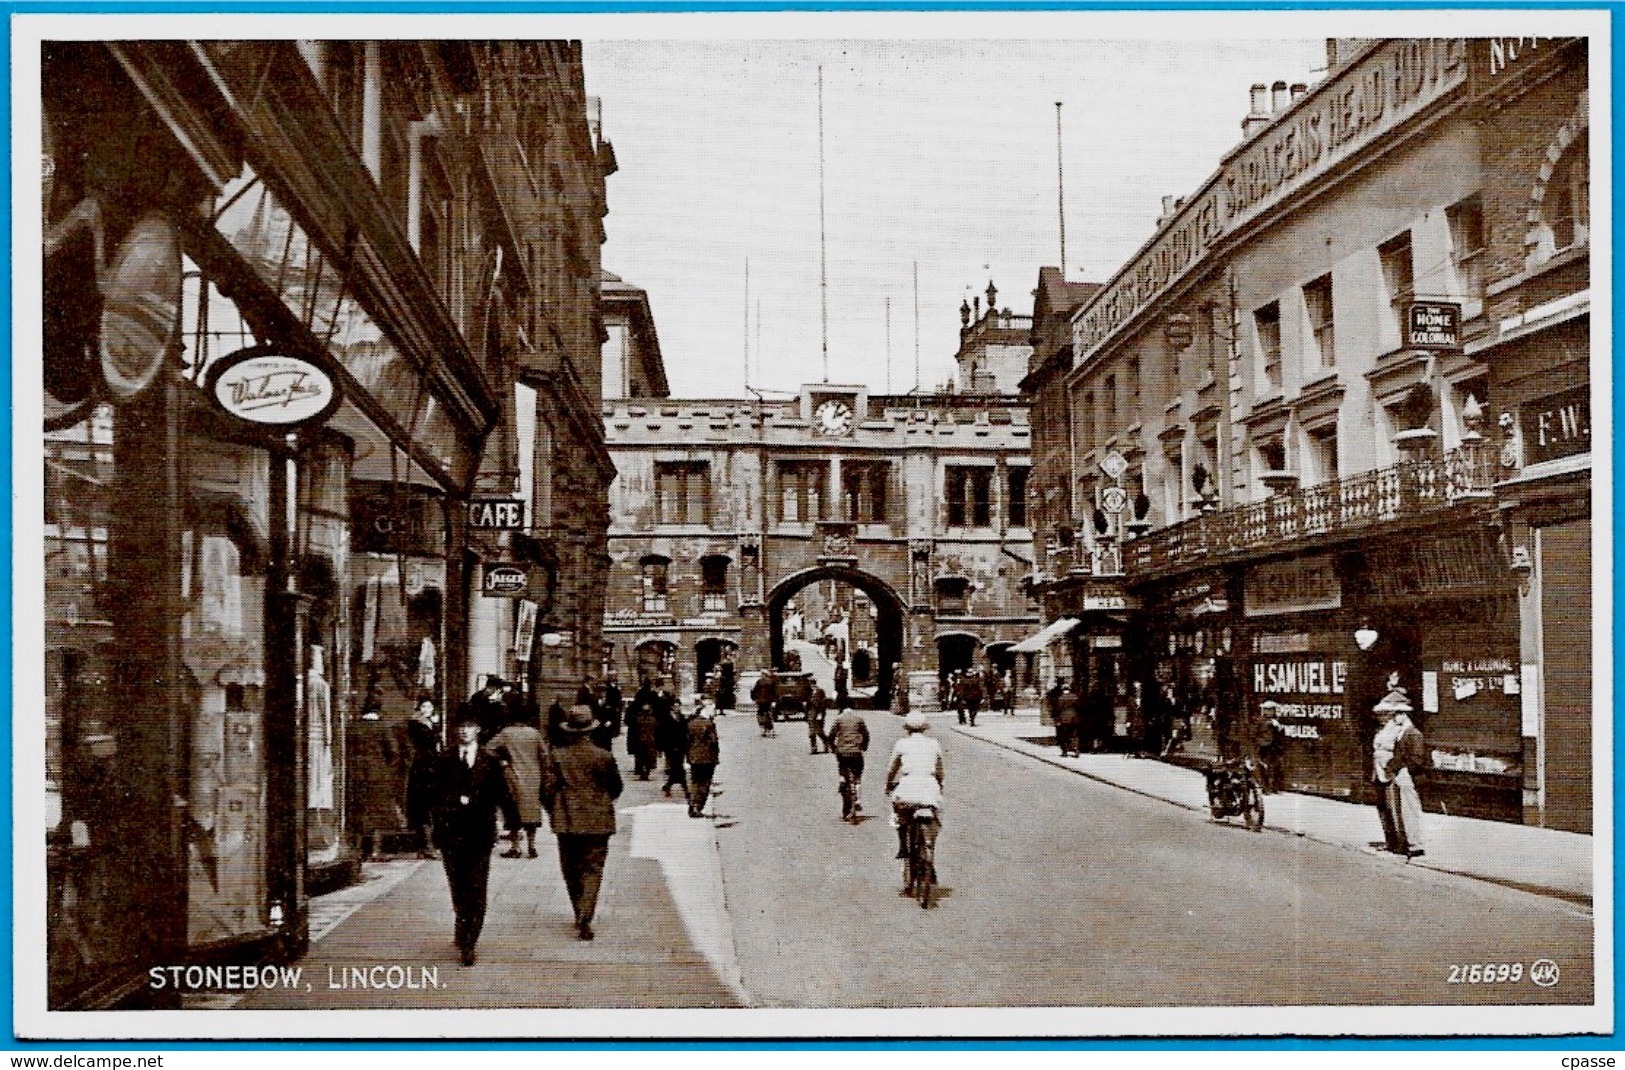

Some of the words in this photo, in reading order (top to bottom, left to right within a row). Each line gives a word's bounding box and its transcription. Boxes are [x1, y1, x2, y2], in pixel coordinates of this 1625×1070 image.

[1329, 70, 1385, 152] HEAD
[1136, 246, 1170, 307] HEAD
[1172, 194, 1225, 276] HOTEL
[1416, 313, 1452, 327] HOME
[1410, 331, 1456, 346] COLONIAL
[469, 502, 521, 528] CAFE
[485, 569, 528, 591] JAEGER
